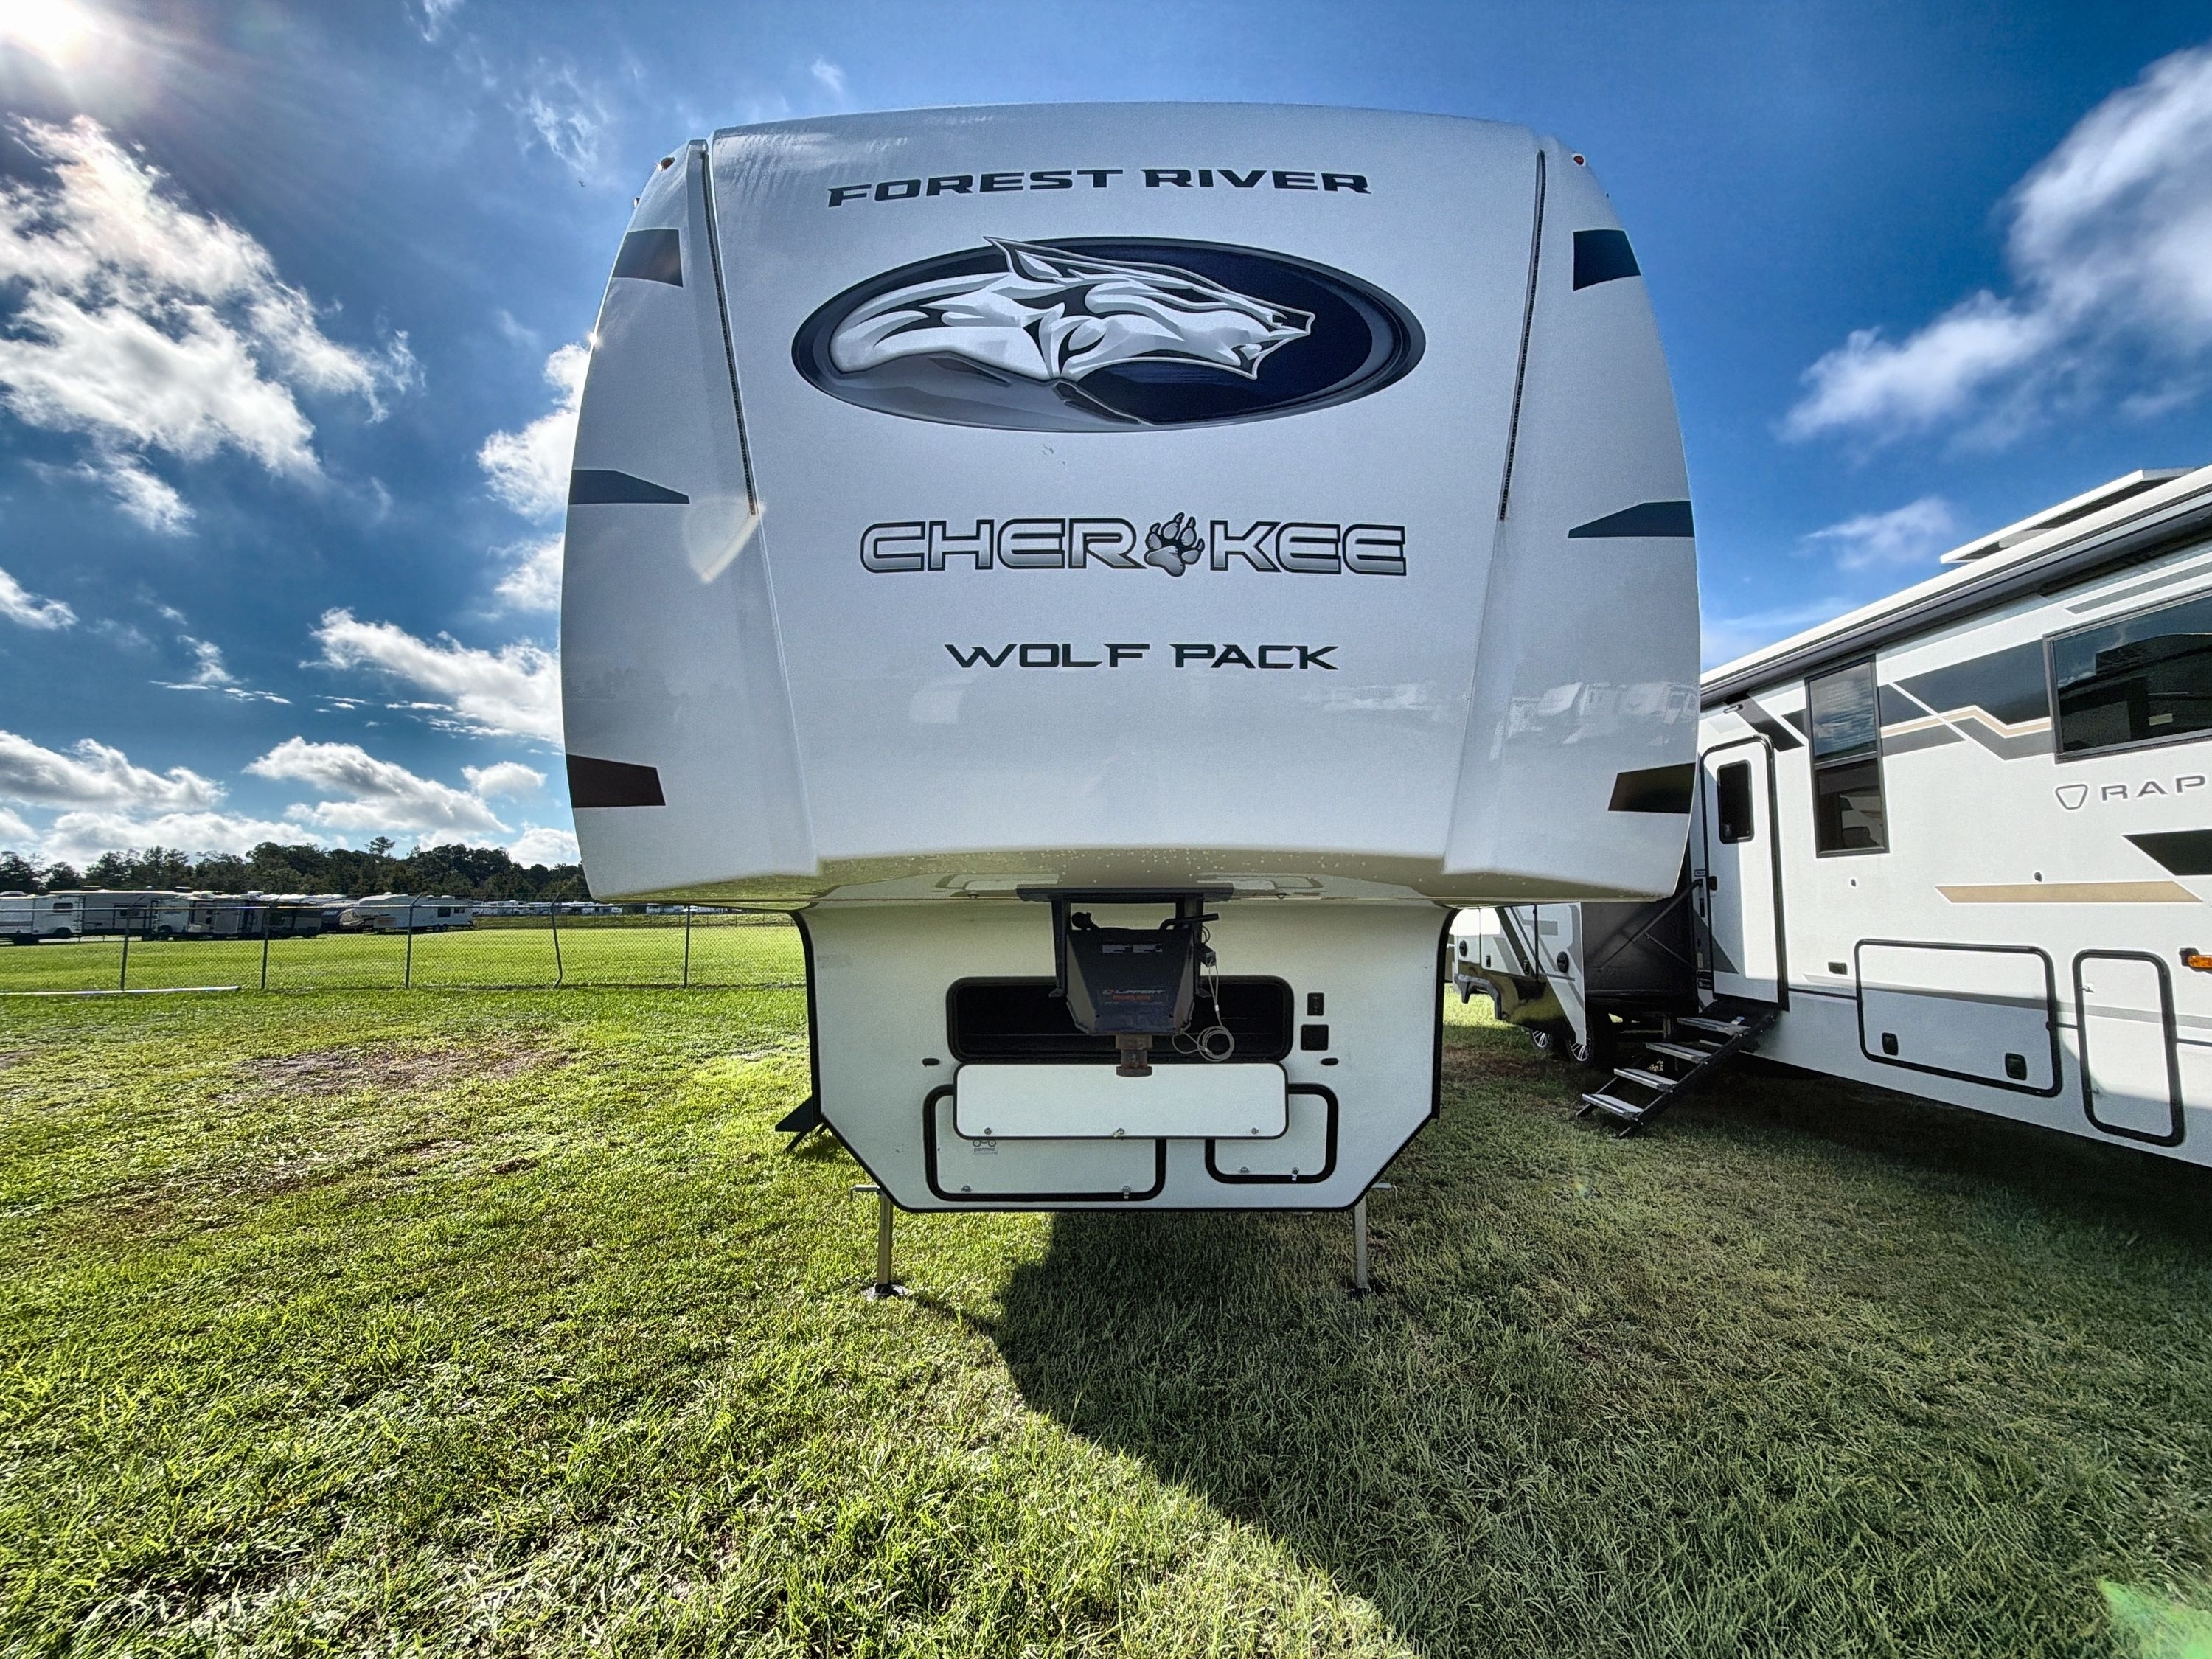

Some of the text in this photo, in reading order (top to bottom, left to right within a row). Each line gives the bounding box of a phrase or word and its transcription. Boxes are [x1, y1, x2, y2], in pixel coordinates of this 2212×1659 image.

[828, 169, 1372, 208] FOREST RIVER
[945, 644, 1340, 671] WOLF PACK
